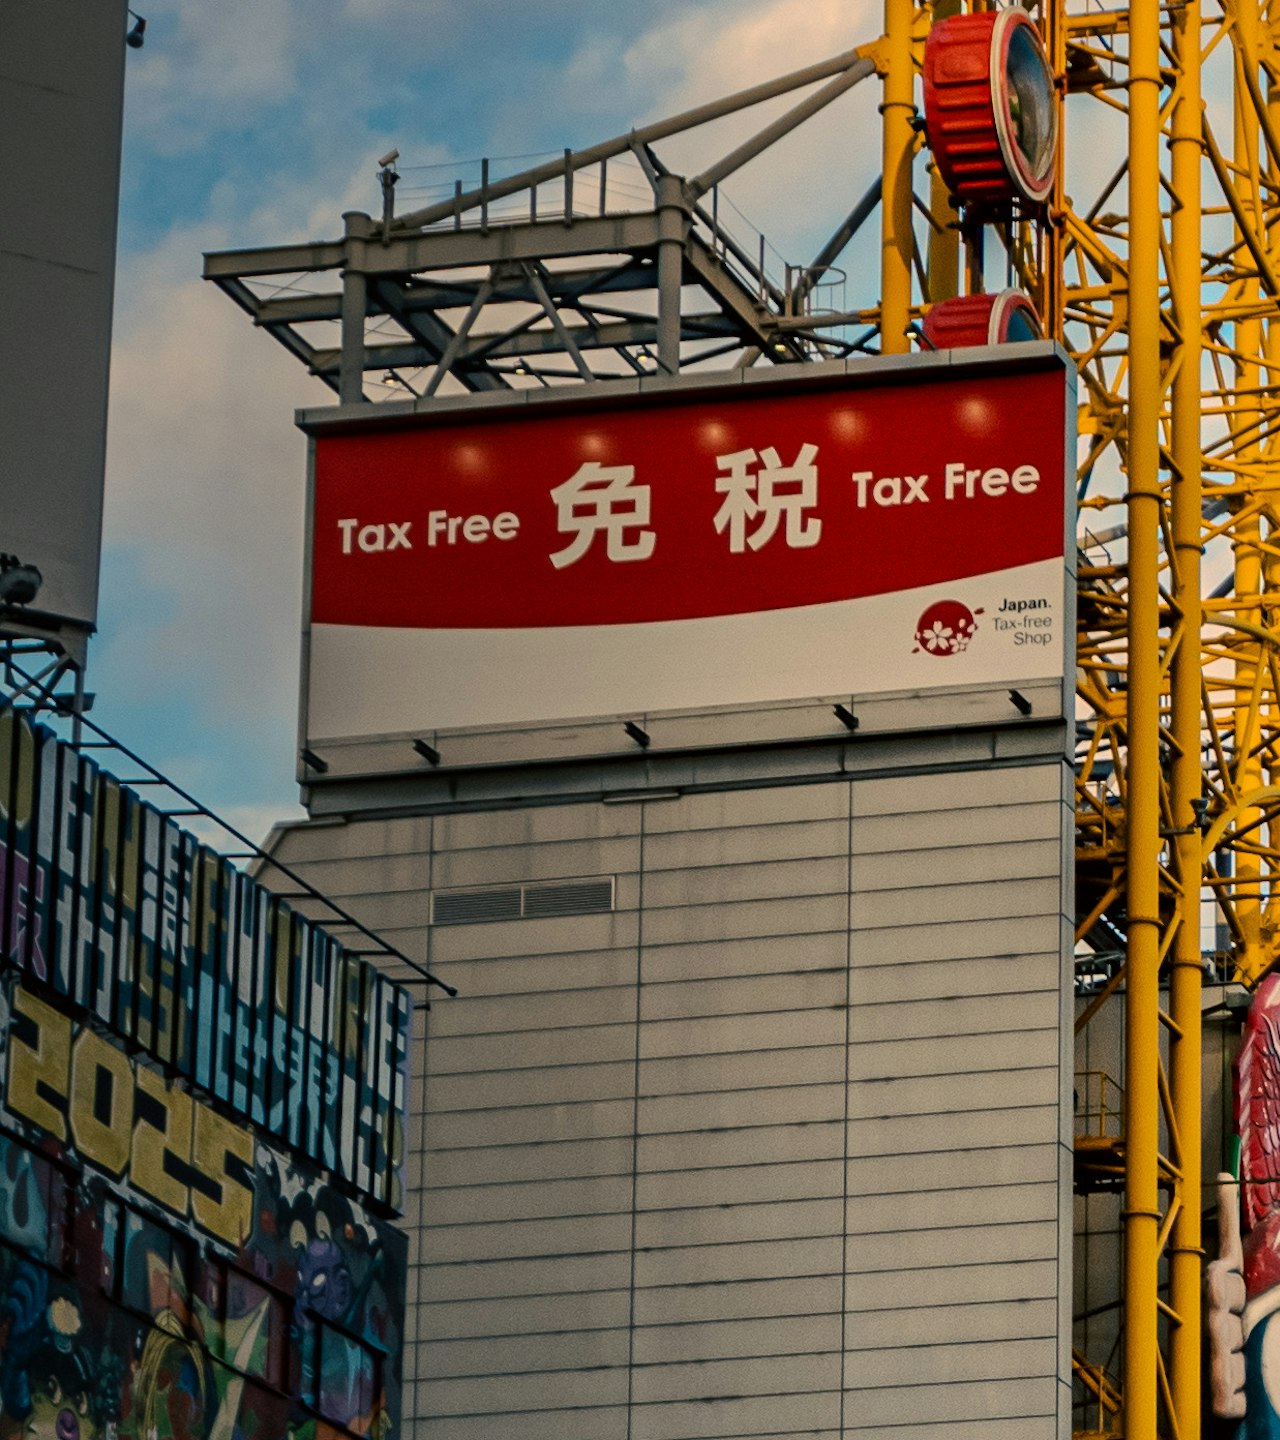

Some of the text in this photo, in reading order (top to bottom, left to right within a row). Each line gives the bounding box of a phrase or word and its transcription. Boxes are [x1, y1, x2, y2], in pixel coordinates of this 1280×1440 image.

[851, 462, 1041, 509] Tax Free
[337, 507, 520, 556] Tax Free
[993, 615, 1052, 631] Tax-free
[1013, 631, 1052, 647] Shop
[6, 985, 255, 1249] 2025
